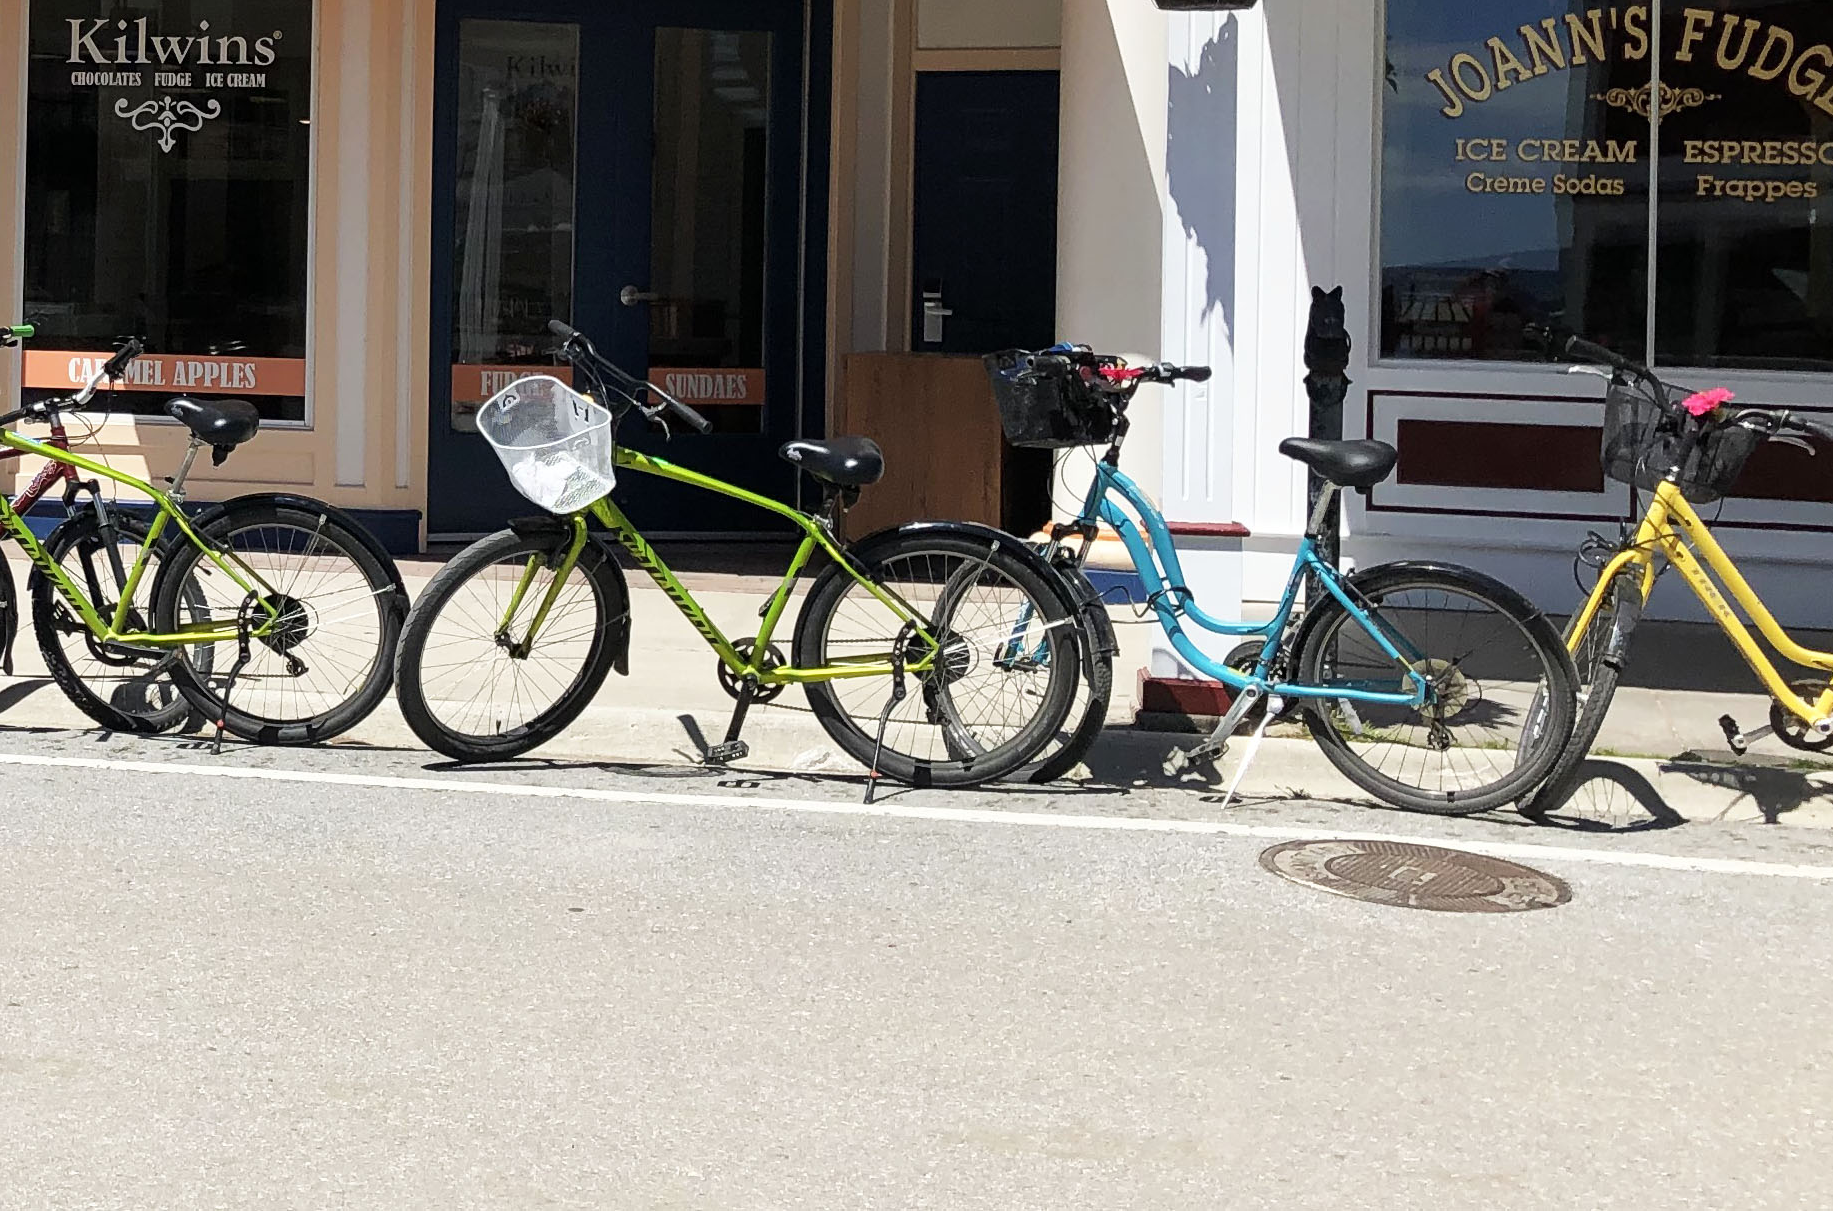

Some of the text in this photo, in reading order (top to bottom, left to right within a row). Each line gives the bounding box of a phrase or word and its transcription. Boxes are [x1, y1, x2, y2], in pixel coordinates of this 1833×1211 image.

[1427, 6, 1648, 118] JOANN'S
[71, 71, 266, 88] CHOCOLATES FUDGE ICE CREAM
[1455, 138, 1638, 163] ICE CREAM
[1553, 173, 1625, 196] Sodas
[1696, 174, 1817, 203] Frappes
[172, 360, 256, 389] APPLES
[665, 373, 747, 400] SUNDAES
